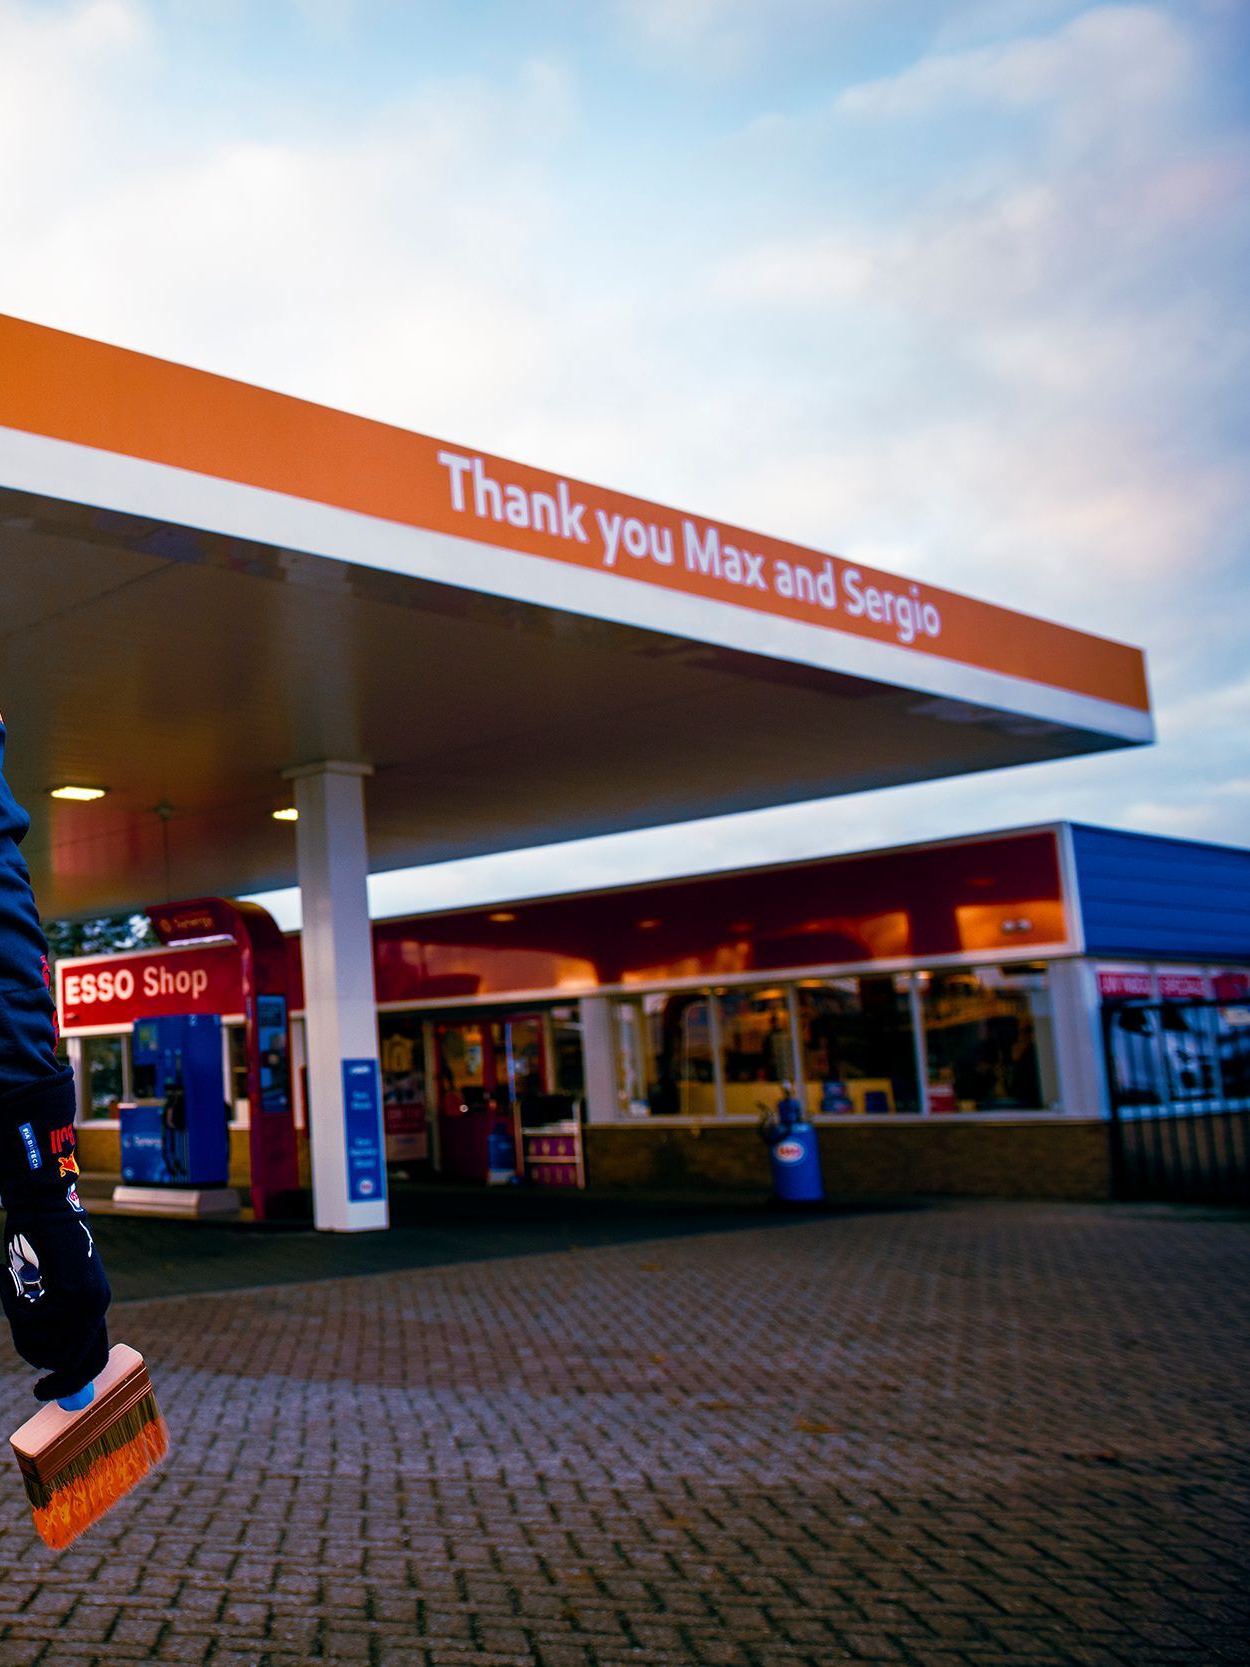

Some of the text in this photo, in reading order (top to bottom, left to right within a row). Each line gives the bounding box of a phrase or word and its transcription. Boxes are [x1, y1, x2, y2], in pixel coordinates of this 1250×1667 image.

[437, 449, 941, 643] Thank you Max and Sergio
[64, 967, 134, 1005] ESSO
[143, 965, 208, 1001] Shop
